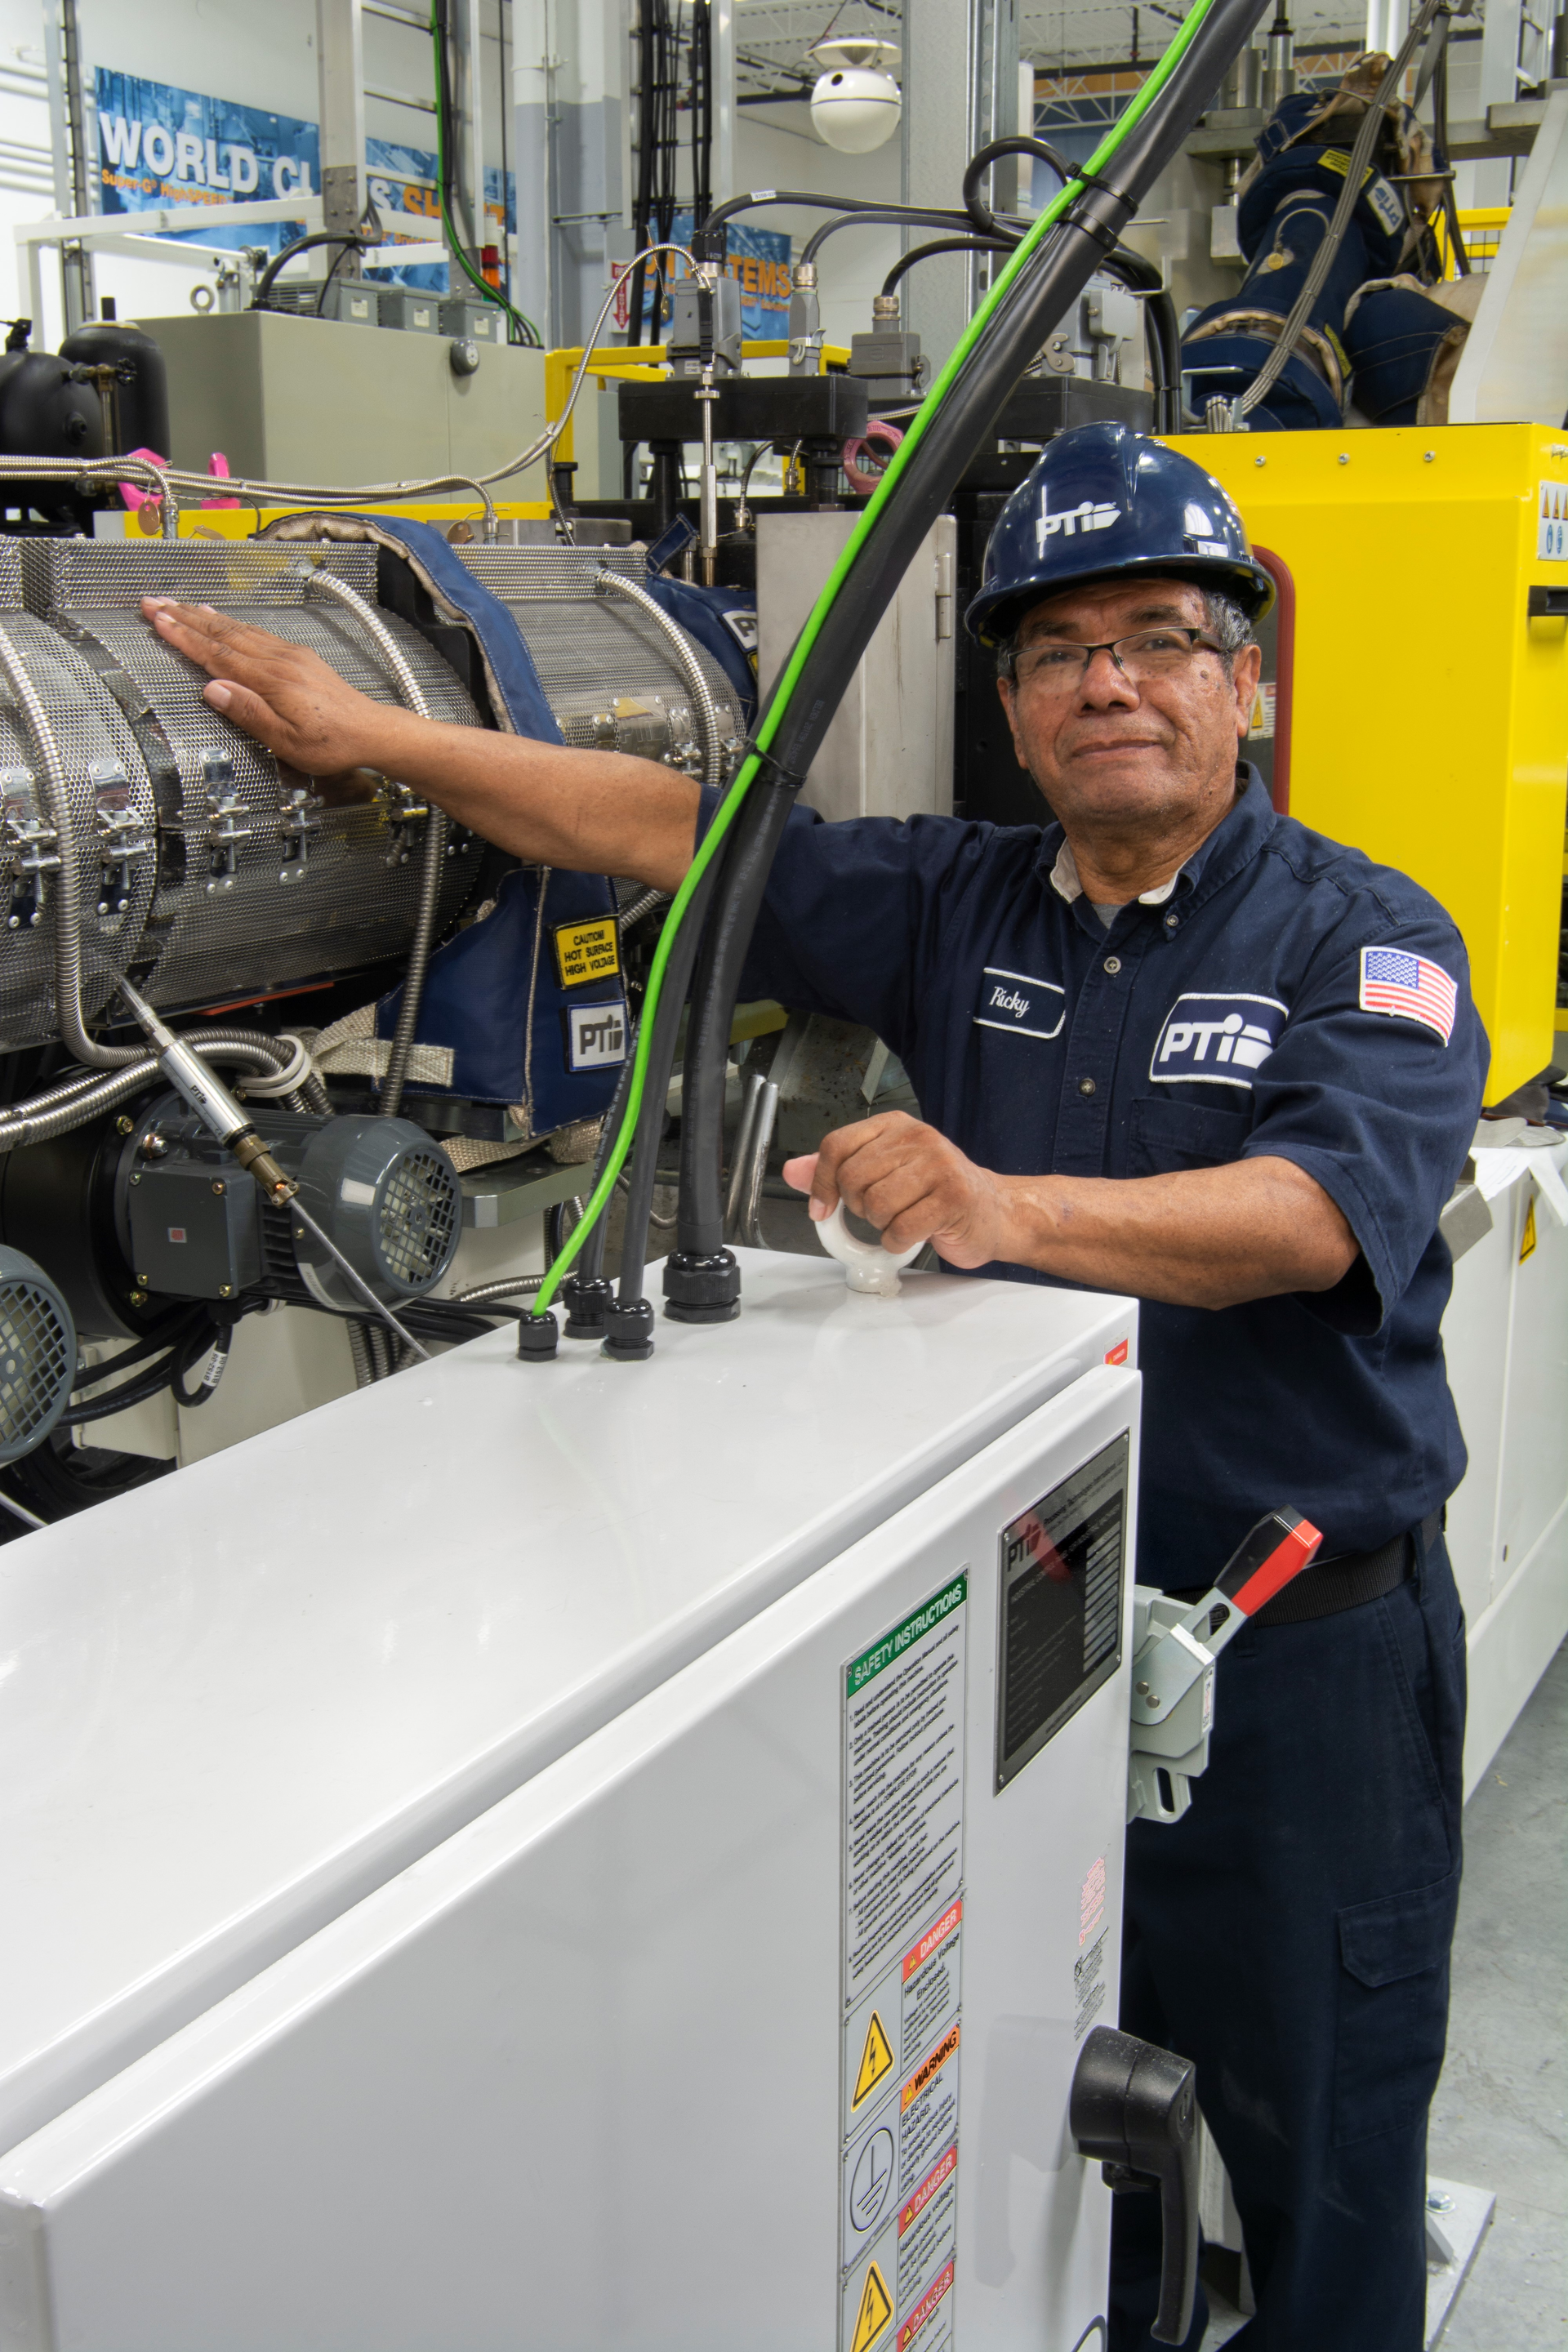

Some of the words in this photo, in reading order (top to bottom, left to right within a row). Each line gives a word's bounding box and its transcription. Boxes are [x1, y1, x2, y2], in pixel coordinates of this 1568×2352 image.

[99, 113, 259, 194] WORLD
[564, 949, 582, 963] HOT
[586, 942, 613, 958] SURFACE
[573, 930, 605, 947] CAUTION!
[565, 963, 587, 976] HIGH
[590, 955, 615, 971] VOLTAGE
[989, 986, 1030, 1018] Ricky
[203, 1352, 219, 1382] B152-05
[855, 1638, 892, 1686] SAFETY
[894, 1581, 961, 1654] INSTRUCTIONS
[920, 1910, 956, 1958] DANGER
[904, 1957, 936, 1998] Hazardous
[937, 1930, 959, 1962] Voltage
[916, 1961, 945, 1999] Enclosed.
[914, 2034, 956, 2091] WARNING
[902, 2071, 942, 2127] ELECTRICAL
[914, 2155, 951, 2212] DANGER
[899, 2209, 931, 2256] Hazardous
[913, 2271, 950, 2329] DANGER
